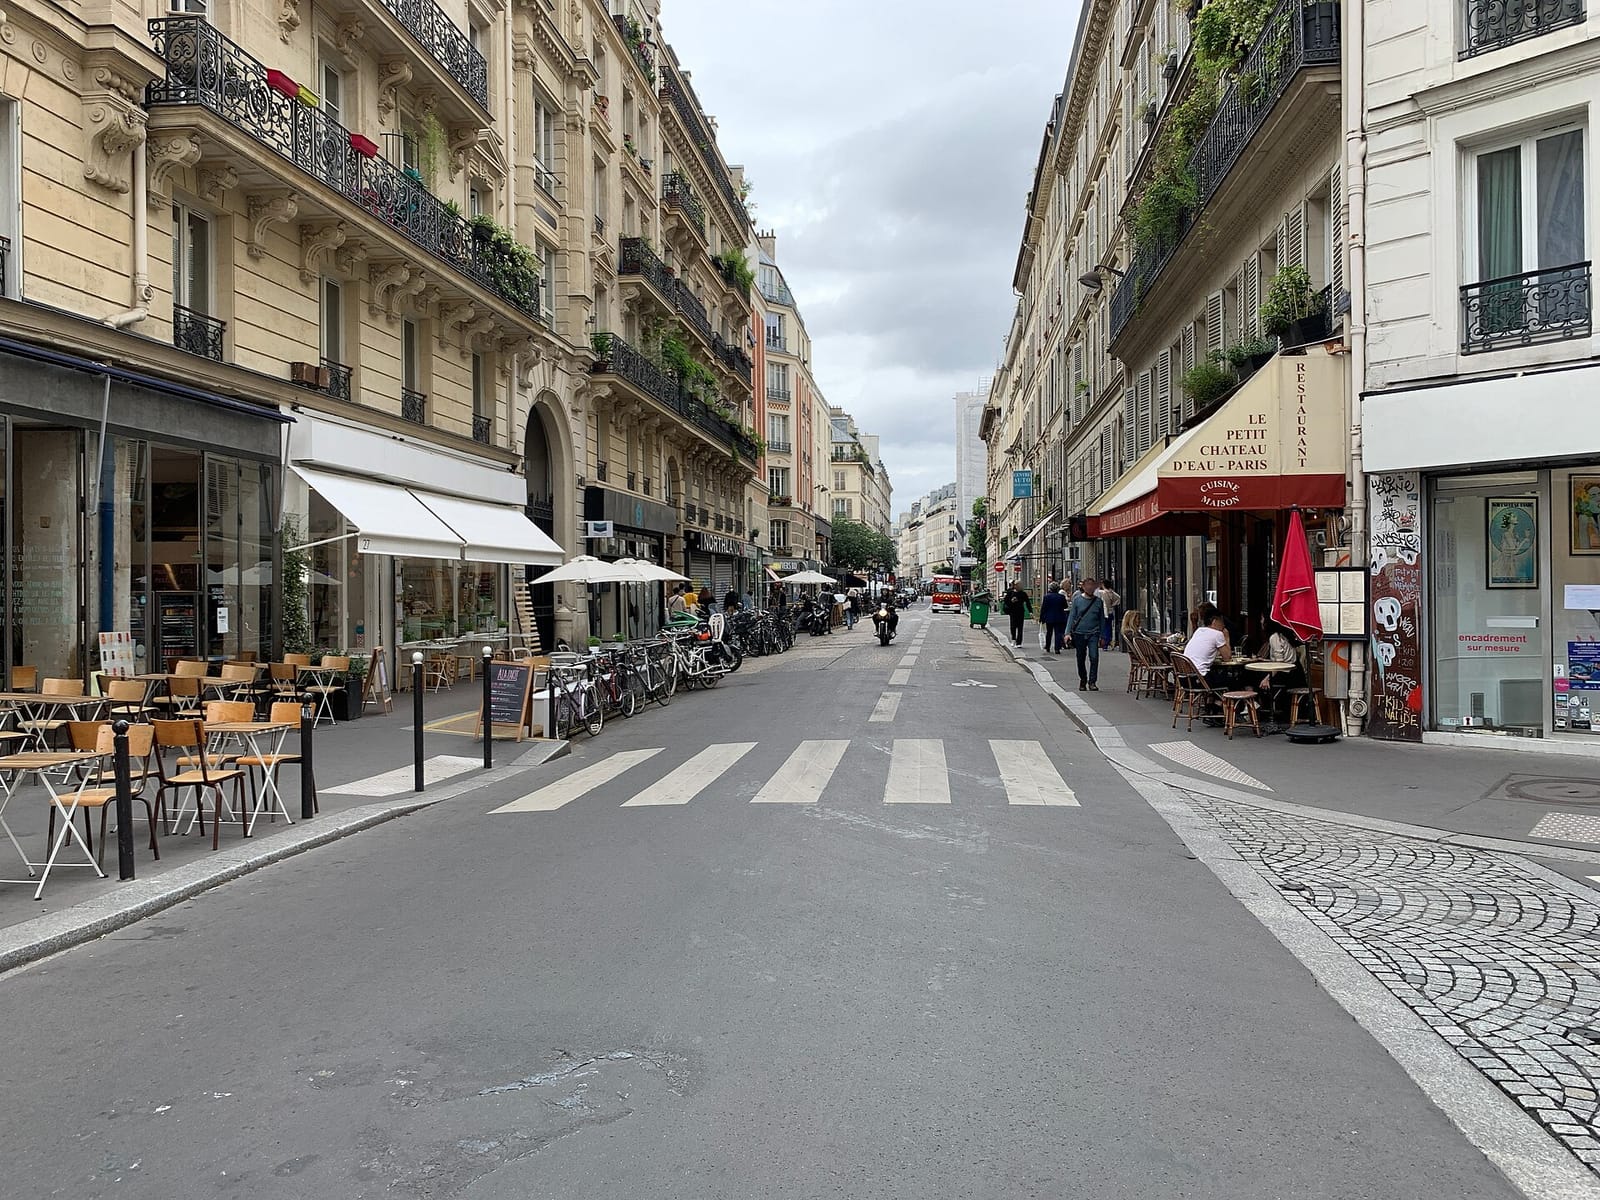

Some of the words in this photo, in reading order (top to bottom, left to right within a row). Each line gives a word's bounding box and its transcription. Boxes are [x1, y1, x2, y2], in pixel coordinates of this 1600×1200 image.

[1249, 414, 1267, 425] LE
[1296, 363, 1307, 468] RESTAURANT
[1227, 429, 1267, 440] PETIT
[1200, 444, 1267, 456] CHATEAU
[1173, 460, 1216, 471] D'EAU
[1228, 459, 1267, 471] PARIS
[1200, 480, 1240, 493] CUISINE
[1200, 495, 1240, 508] MAISON
[363, 539, 371, 550] 27
[1458, 633, 1528, 643] encadrement
